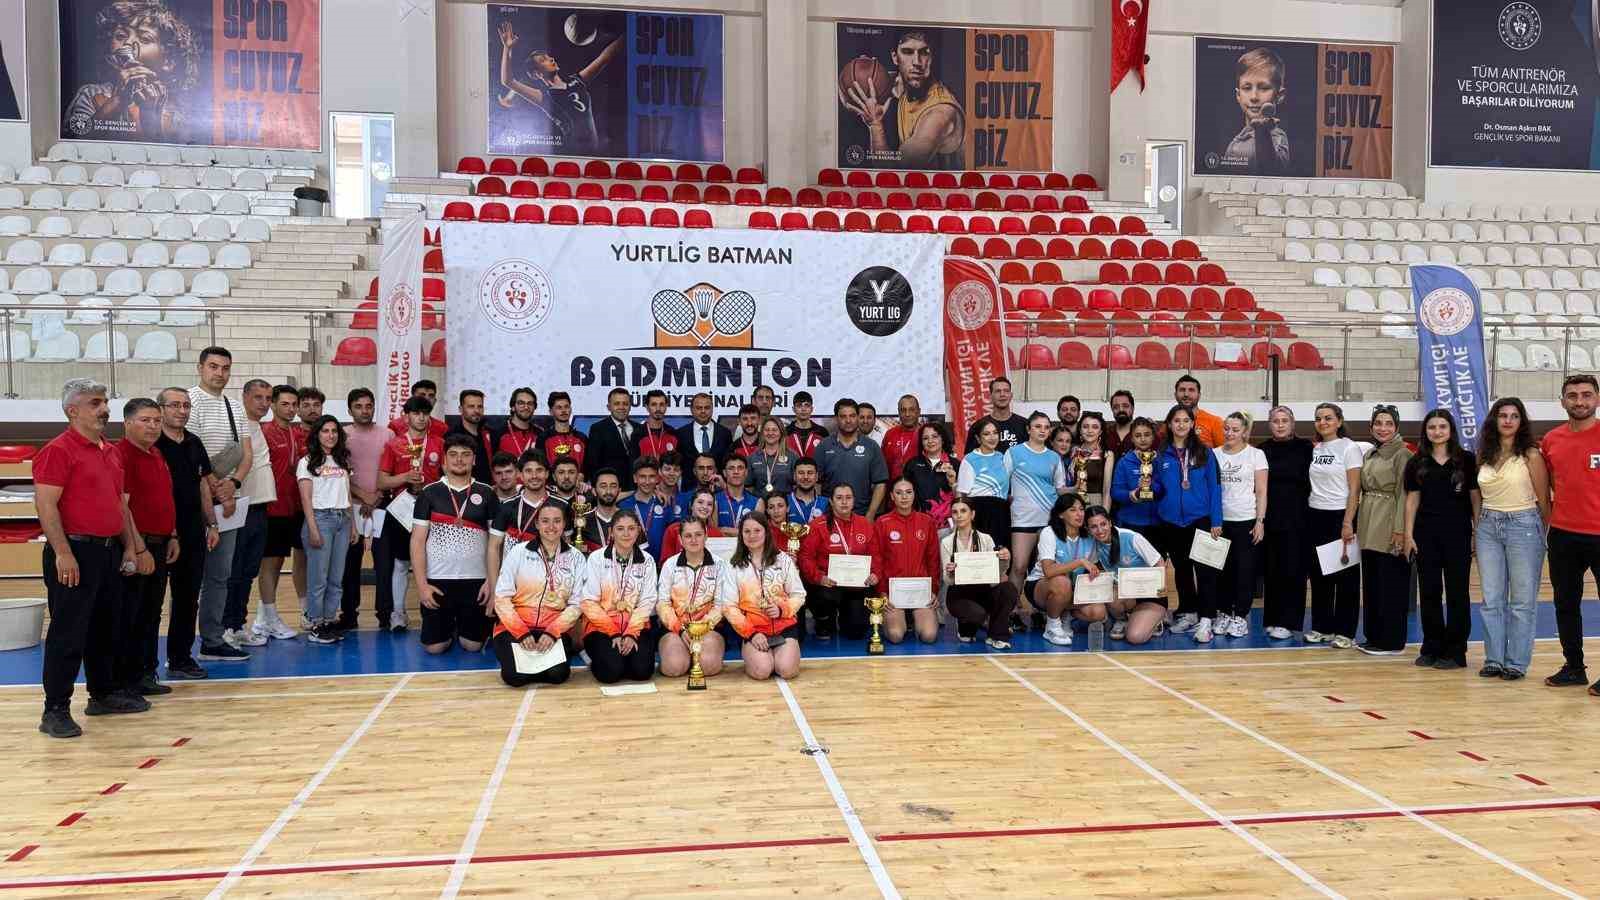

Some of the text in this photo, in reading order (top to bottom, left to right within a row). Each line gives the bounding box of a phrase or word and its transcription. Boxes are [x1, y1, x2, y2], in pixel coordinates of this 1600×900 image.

[224, 0, 288, 41] SPOR
[975, 33, 1028, 72] SPOR
[1325, 50, 1371, 86] SPOR
[1472, 65, 1566, 82] TÜM ANTRENÖR
[1457, 79, 1579, 97] VE SPORCULARIMIZA
[1461, 95, 1574, 109] BAŞARILAR DİLİYORUM
[1484, 123, 1493, 131] Dr.
[1494, 123, 1517, 131] Osman
[975, 124, 1008, 167] BİZ
[1473, 132, 1561, 143] GENÇLİK VE SPOR BAKANI
[1324, 132, 1353, 170] BİZ
[611, 241, 792, 265] YURTLİG BATMAN
[860, 306, 884, 319] YURT
[389, 351, 399, 369] VE
